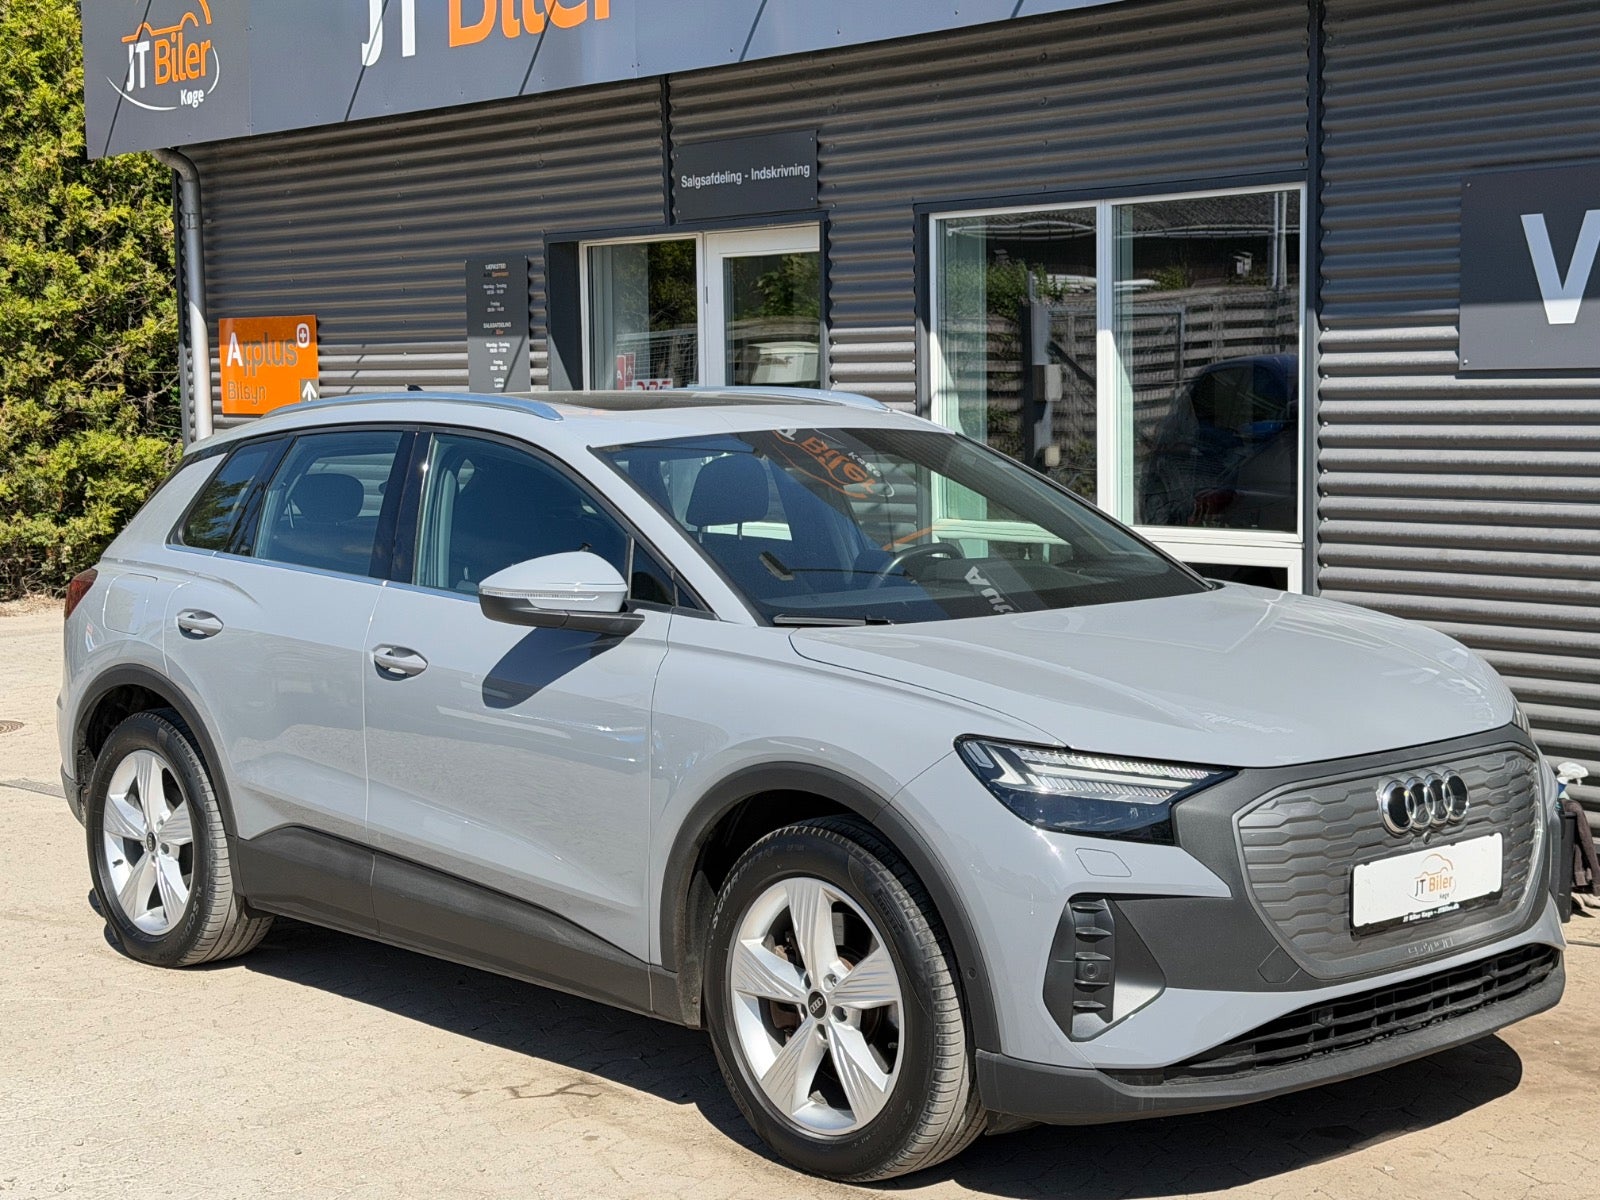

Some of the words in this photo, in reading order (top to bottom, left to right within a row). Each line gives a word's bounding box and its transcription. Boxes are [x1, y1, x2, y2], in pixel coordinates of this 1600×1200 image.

[126, 40, 150, 92] JT
[154, 32, 211, 85] Biler
[180, 89, 205, 108] Køge
[681, 170, 742, 189] Salgsafdeling
[751, 163, 810, 181] Indskrivning
[227, 380, 266, 406] Bilsyn
[1414, 878, 1426, 897] JT
[1429, 874, 1453, 892] Biler
